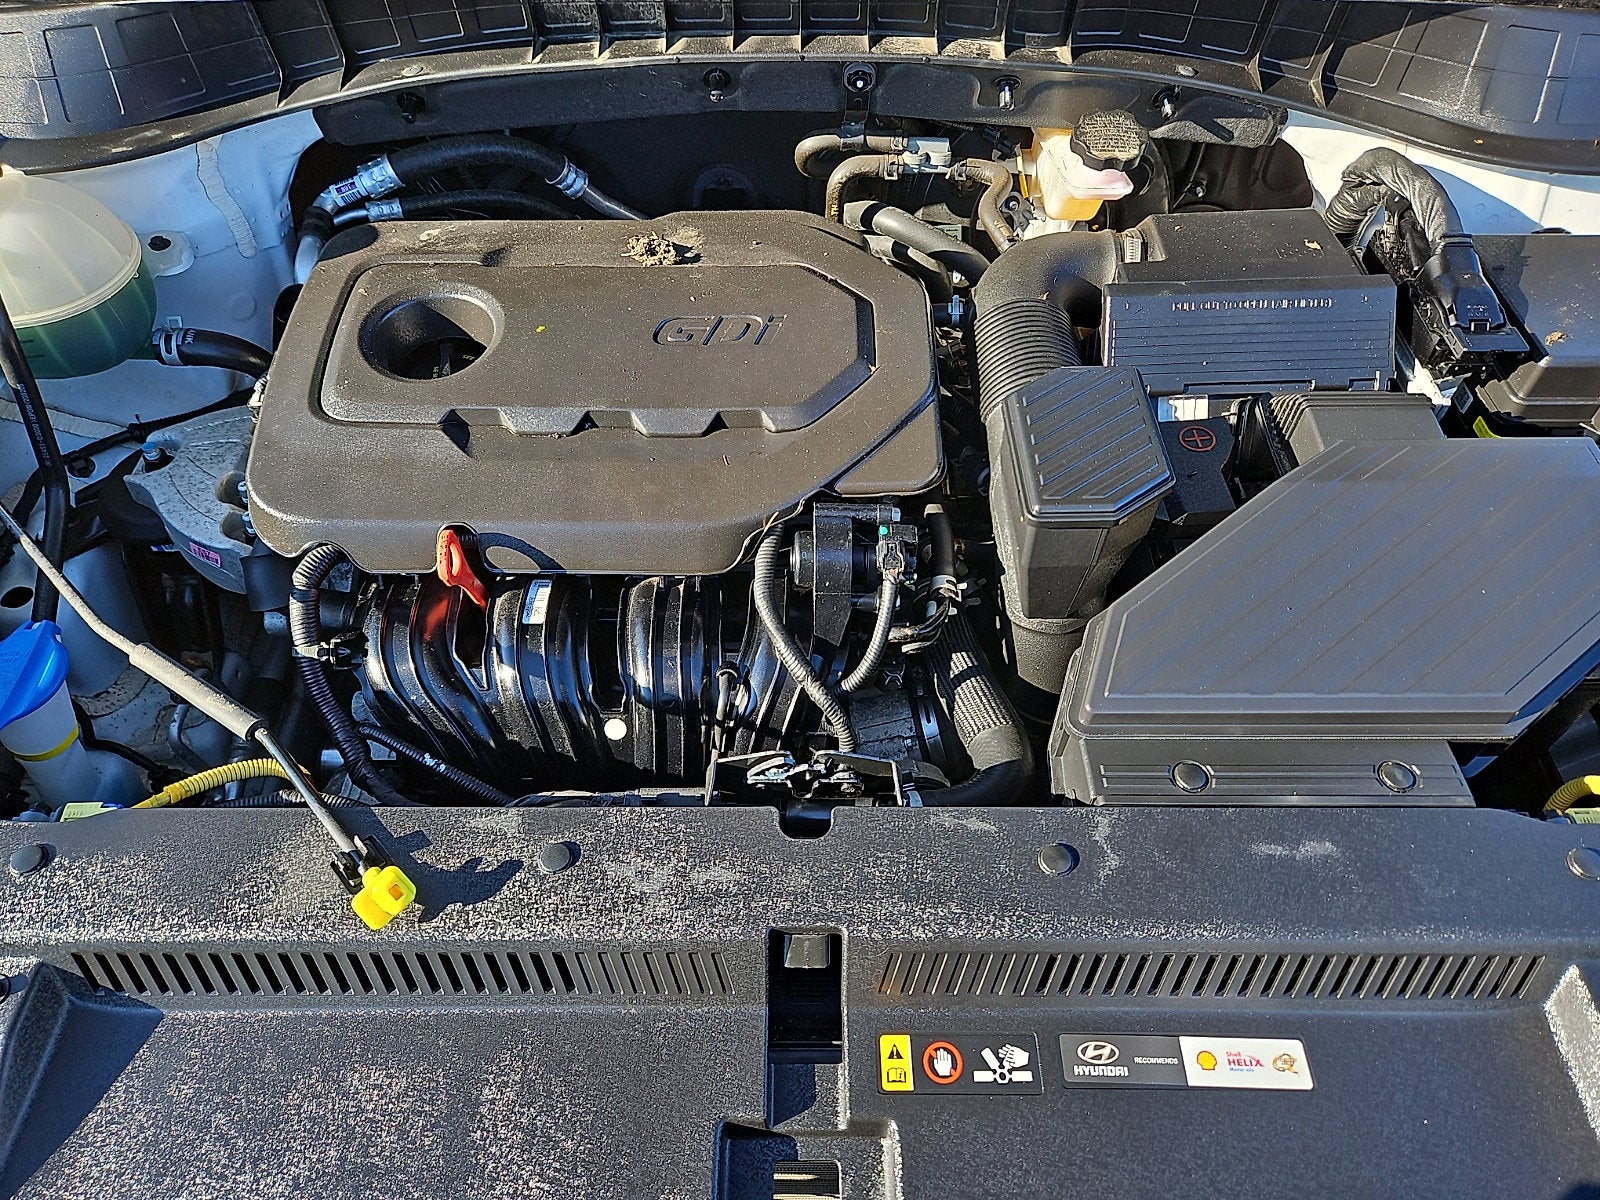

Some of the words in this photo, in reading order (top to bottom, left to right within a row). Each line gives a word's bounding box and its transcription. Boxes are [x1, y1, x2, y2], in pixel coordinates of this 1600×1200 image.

[1200, 301, 1221, 311] OUT
[1223, 300, 1237, 310] TO
[1133, 1057, 1178, 1065] RECOMMENDS
[1227, 1058, 1265, 1067] HELIX
[1074, 1065, 1129, 1077] HYUNDAI
